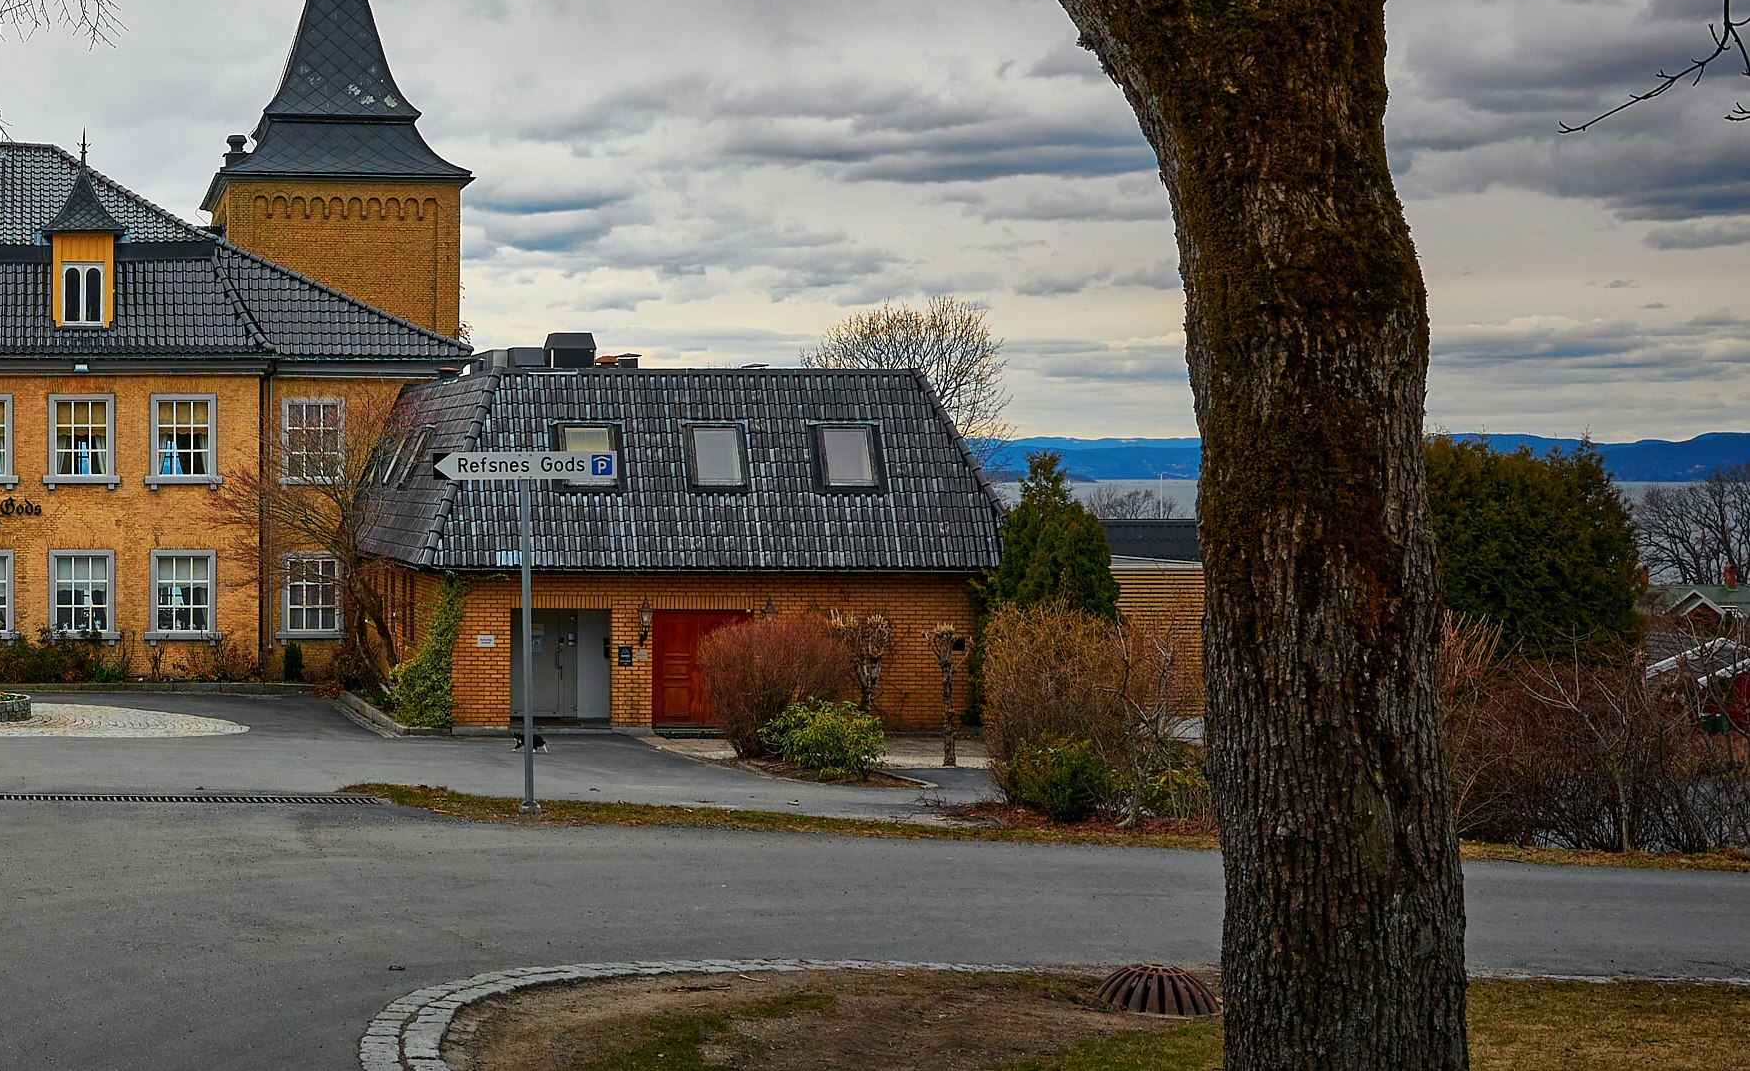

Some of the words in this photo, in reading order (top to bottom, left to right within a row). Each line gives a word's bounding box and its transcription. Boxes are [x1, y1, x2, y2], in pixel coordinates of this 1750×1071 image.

[457, 457, 530, 474] Refsnes
[540, 456, 586, 473] Gods
[597, 460, 607, 474] P
[0, 496, 42, 516] Gods
